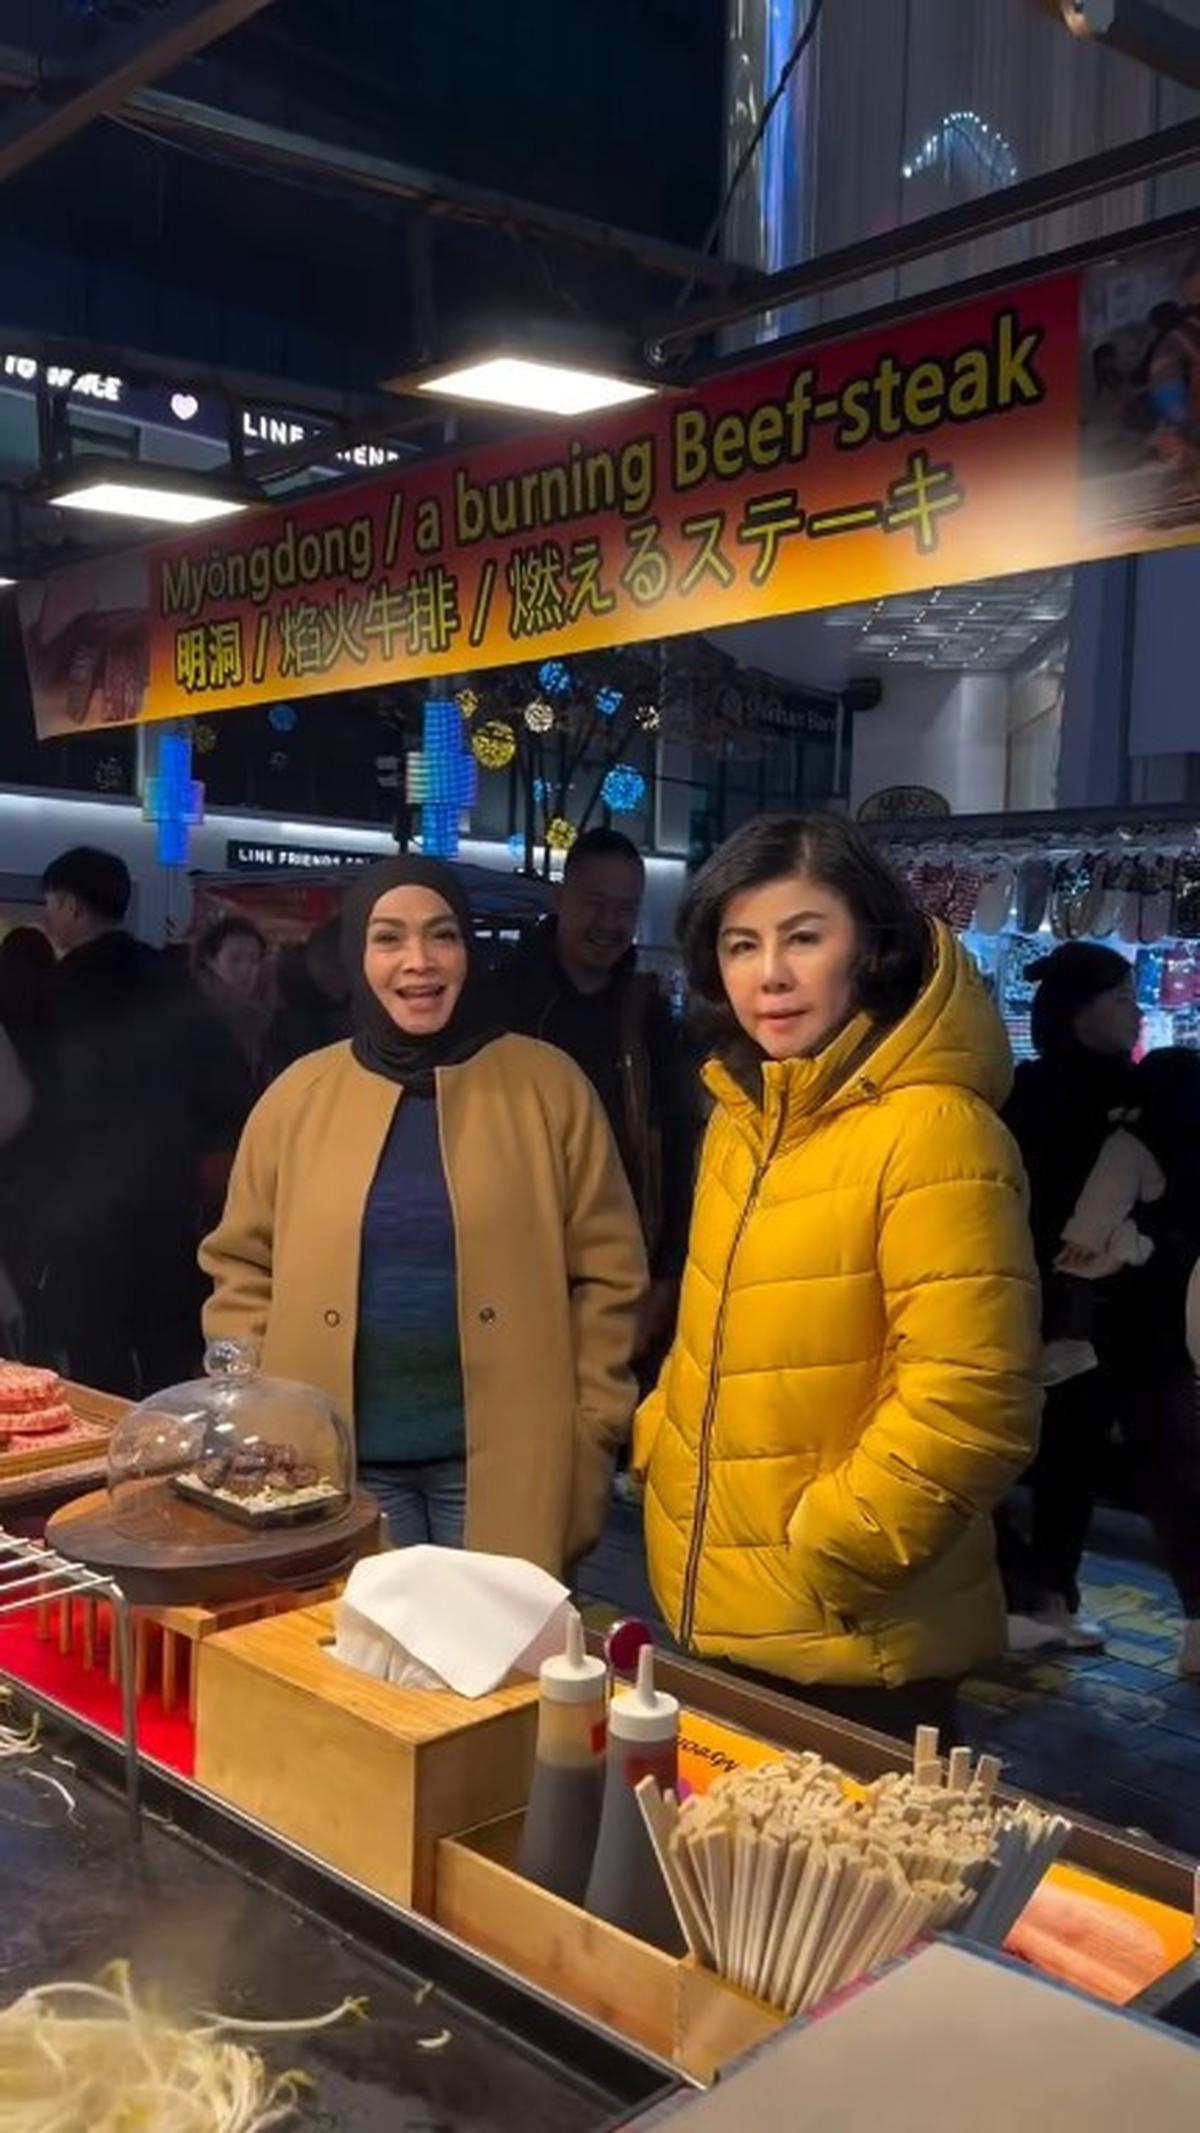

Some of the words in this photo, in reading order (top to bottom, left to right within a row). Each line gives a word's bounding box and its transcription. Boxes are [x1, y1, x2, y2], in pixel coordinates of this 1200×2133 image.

[386, 495, 402, 564] /
[417, 504, 441, 549] a
[457, 438, 652, 539] burning
[674, 314, 1042, 486] Beef-steak
[176, 622, 242, 690] 明洞
[254, 615, 268, 681] /
[279, 569, 458, 675] 焰火牛排
[472, 565, 493, 645] /
[510, 461, 961, 631] 燃えるステーキ
